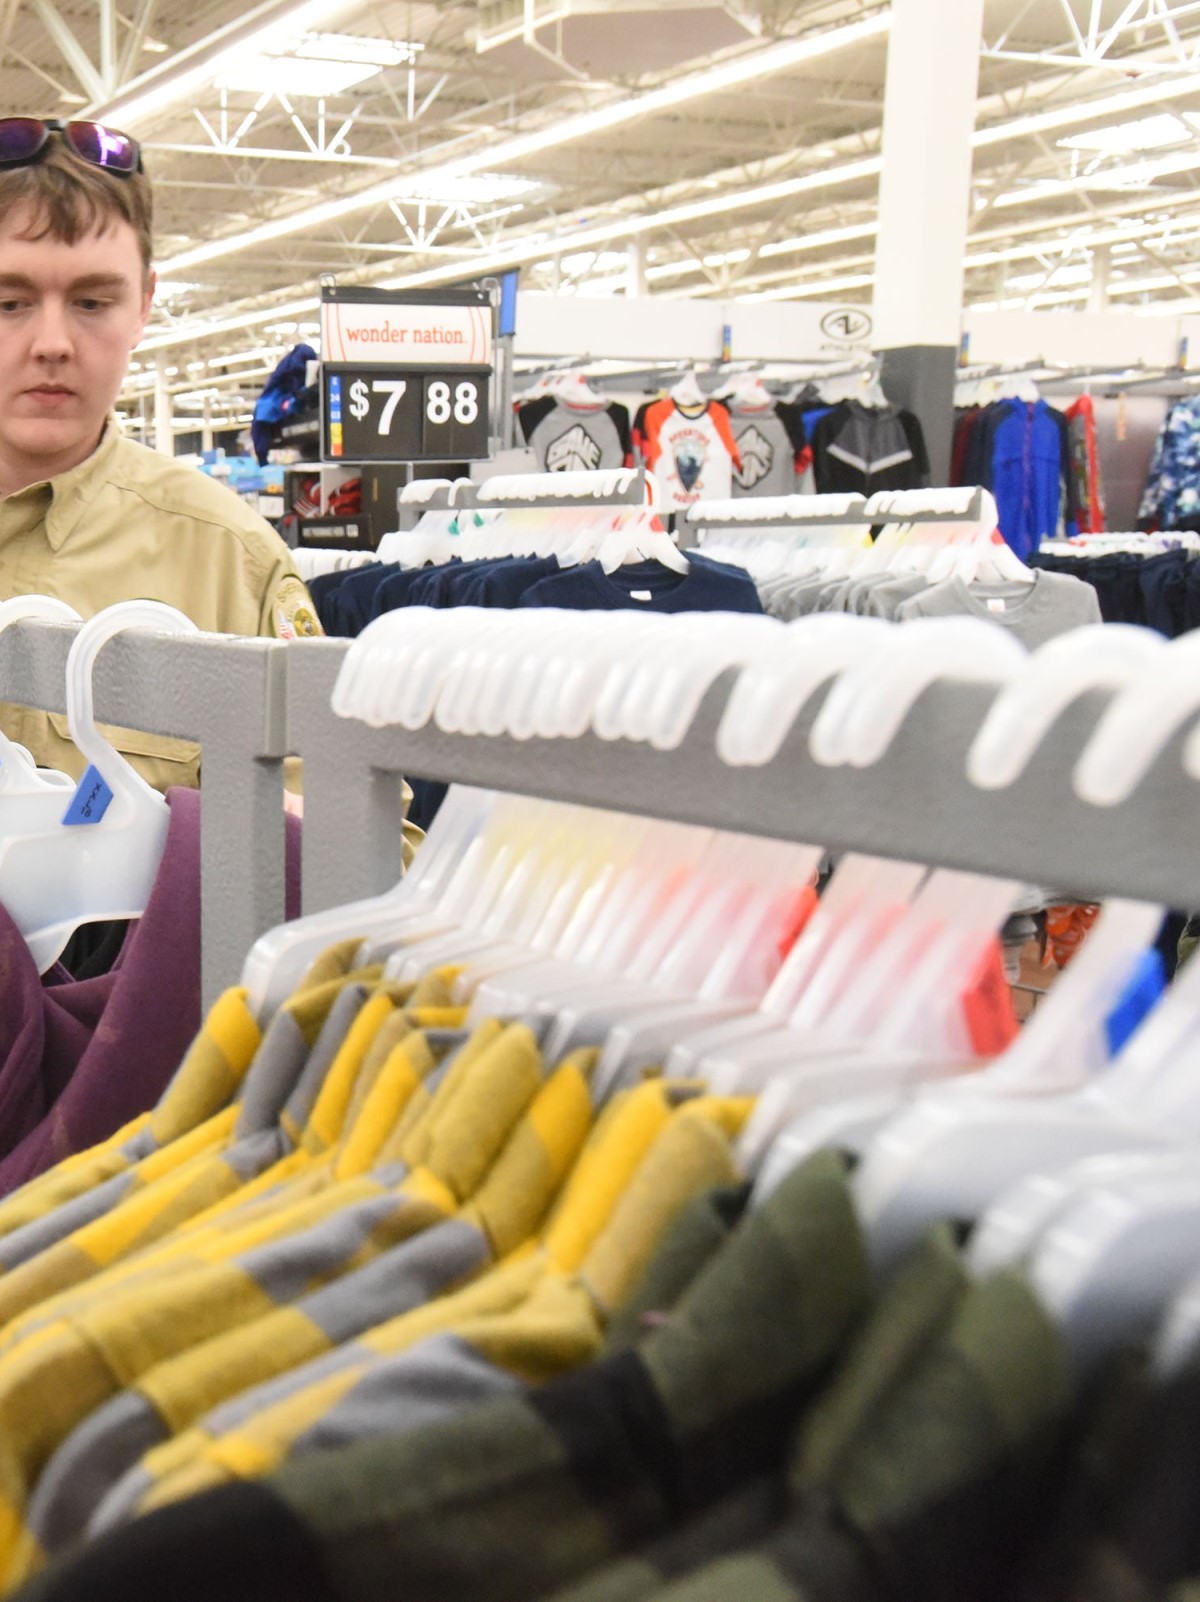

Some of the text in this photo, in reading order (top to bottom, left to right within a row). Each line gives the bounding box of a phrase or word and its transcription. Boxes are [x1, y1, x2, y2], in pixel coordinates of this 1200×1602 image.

[346, 320, 464, 344] wonder nation
[427, 381, 478, 424] 88
[81, 806, 92, 818] 18
